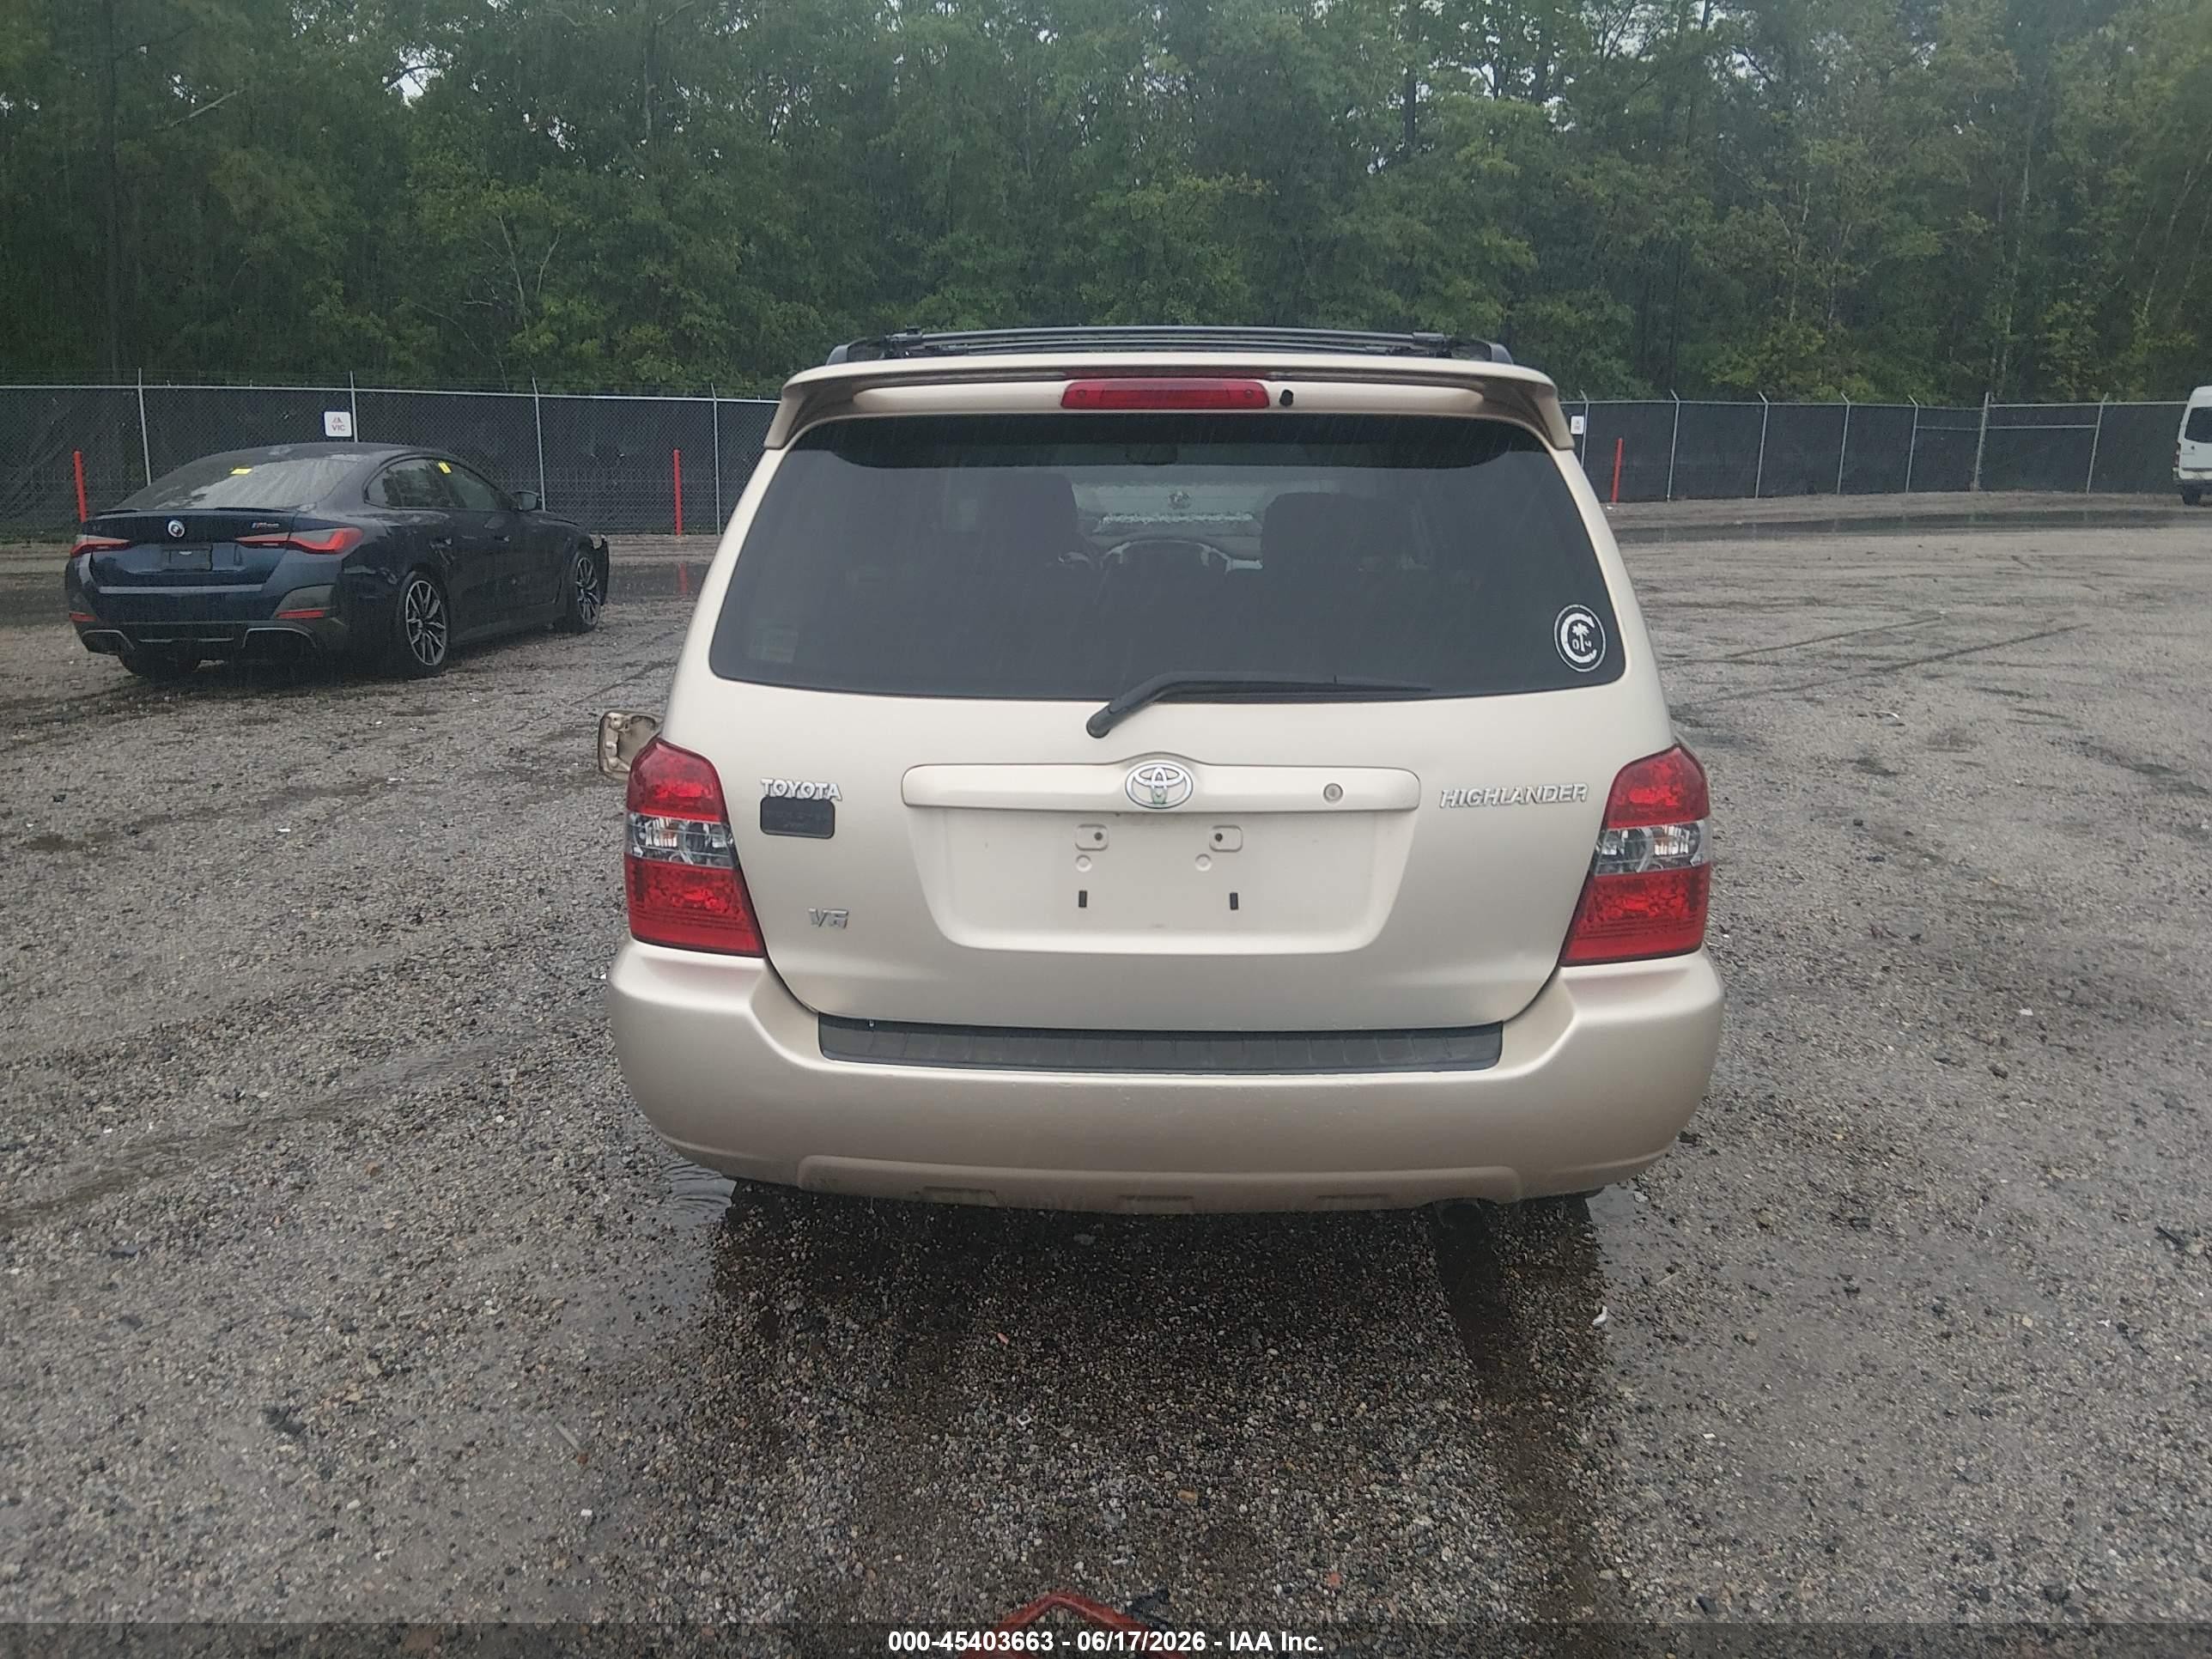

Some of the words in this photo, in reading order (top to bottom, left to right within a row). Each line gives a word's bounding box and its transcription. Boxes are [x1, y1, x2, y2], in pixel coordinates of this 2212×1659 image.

[761, 777, 843, 801] TOYOTA
[1439, 782, 1588, 809] HIGHLANDER
[808, 907, 849, 930] V6
